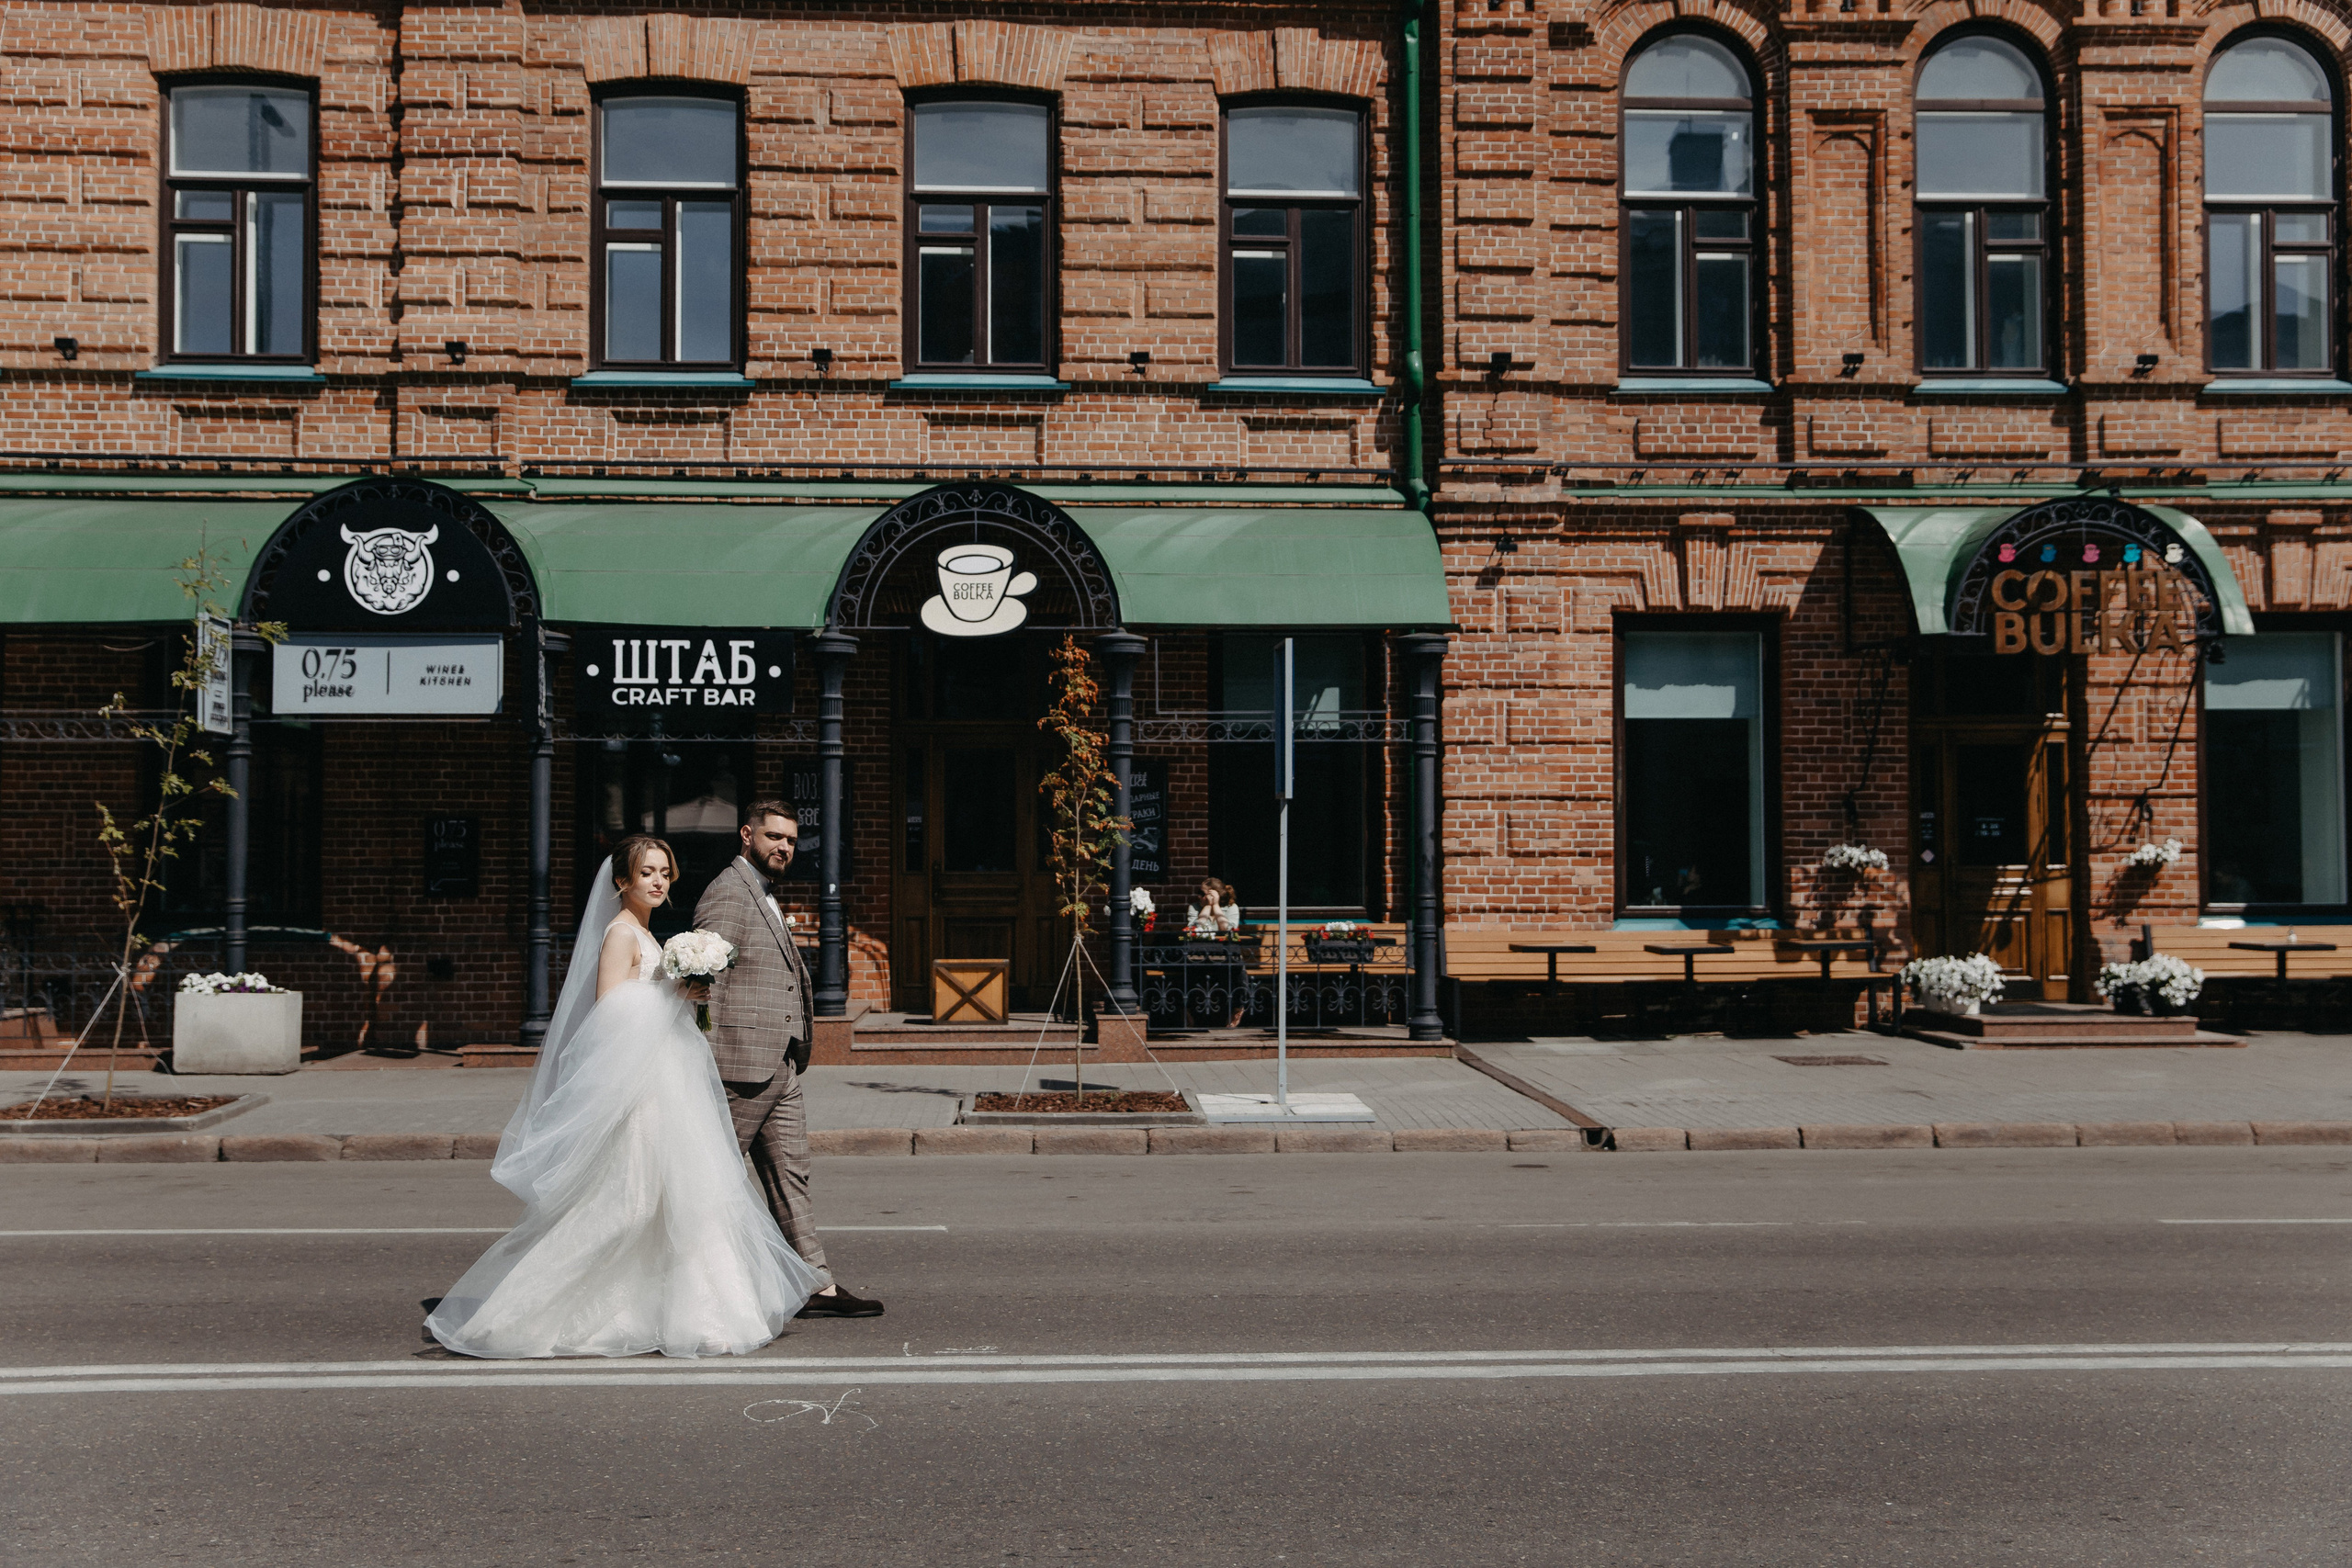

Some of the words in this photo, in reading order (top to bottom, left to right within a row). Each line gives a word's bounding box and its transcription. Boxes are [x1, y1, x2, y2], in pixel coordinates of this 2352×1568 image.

[953, 582, 993, 592] COFFEE
[953, 591, 994, 600] BULKA
[1992, 569, 2182, 612] COFFEE
[1995, 611, 2185, 655] BULKA
[613, 638, 756, 684] ШТАБ
[303, 679, 356, 703] please
[612, 688, 697, 706] CRAFT
[704, 688, 756, 706] BAR
[1131, 859, 1159, 872] ДЕНЬ
